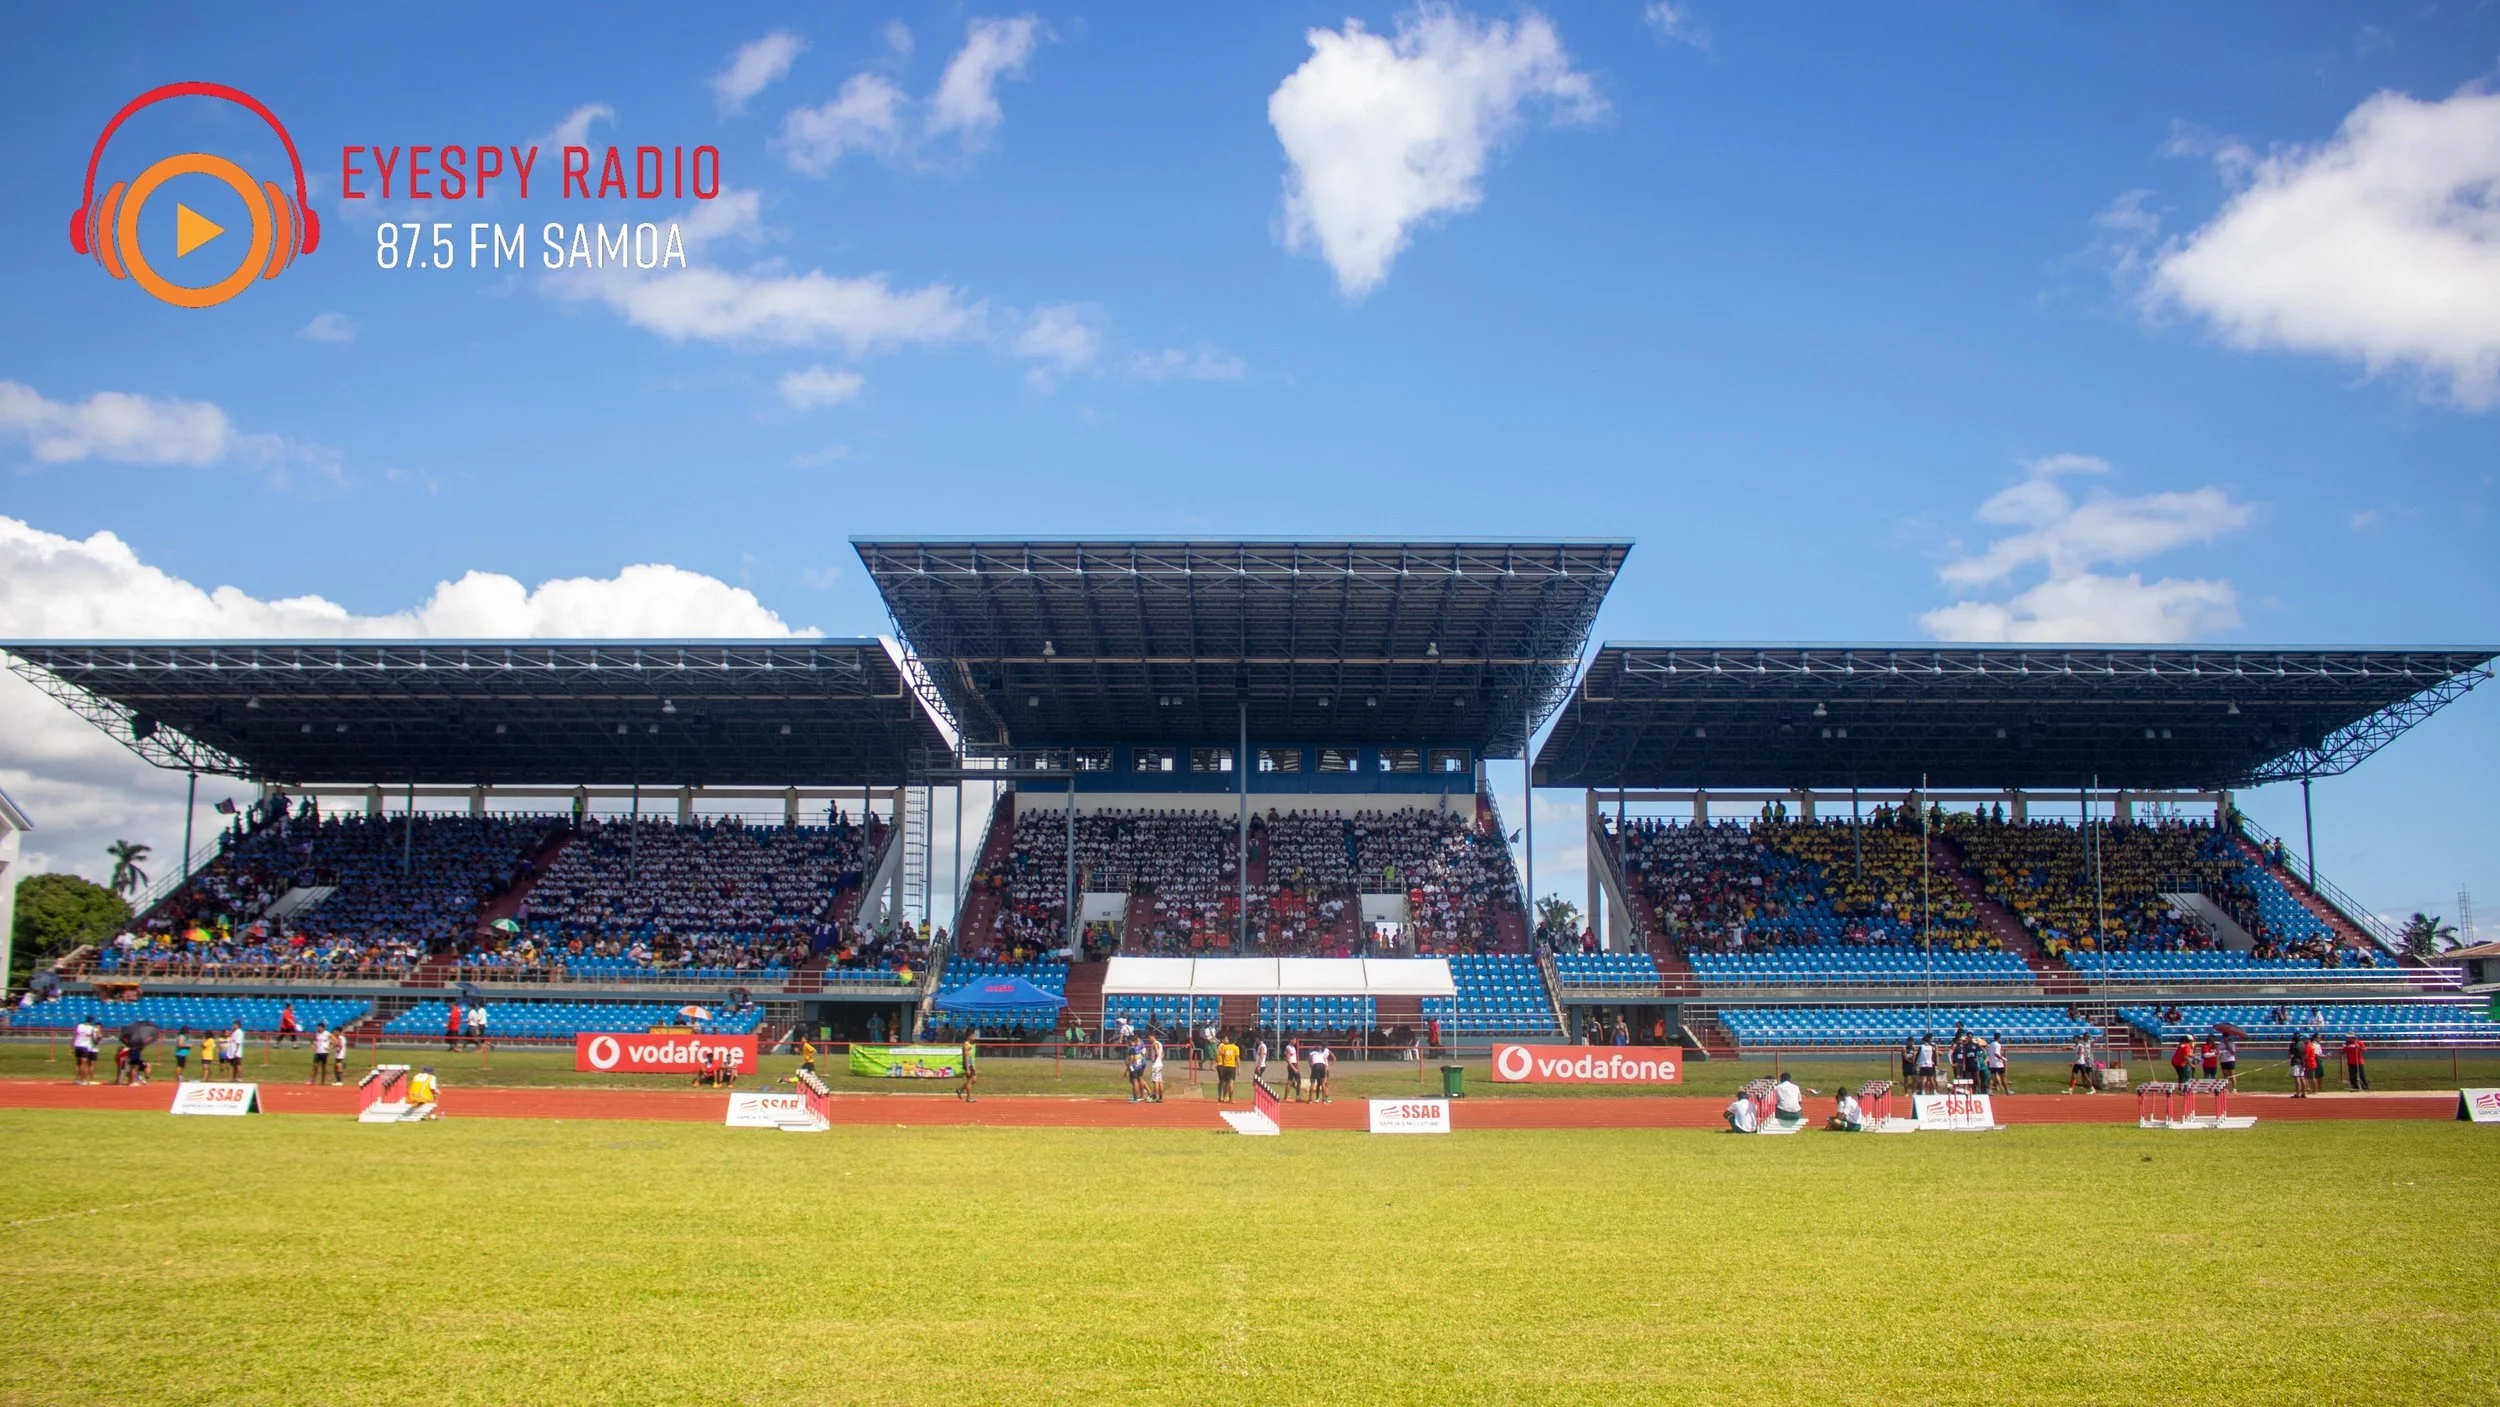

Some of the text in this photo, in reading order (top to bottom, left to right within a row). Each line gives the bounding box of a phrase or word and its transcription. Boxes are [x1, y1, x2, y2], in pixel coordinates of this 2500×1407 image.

[628, 1040, 744, 1065] vodafone
[1537, 1054, 1676, 1080] vodafone
[207, 1088, 244, 1102] SSAB
[1401, 1104, 1441, 1119] SSAB
[1946, 1099, 1984, 1115] SSAB
